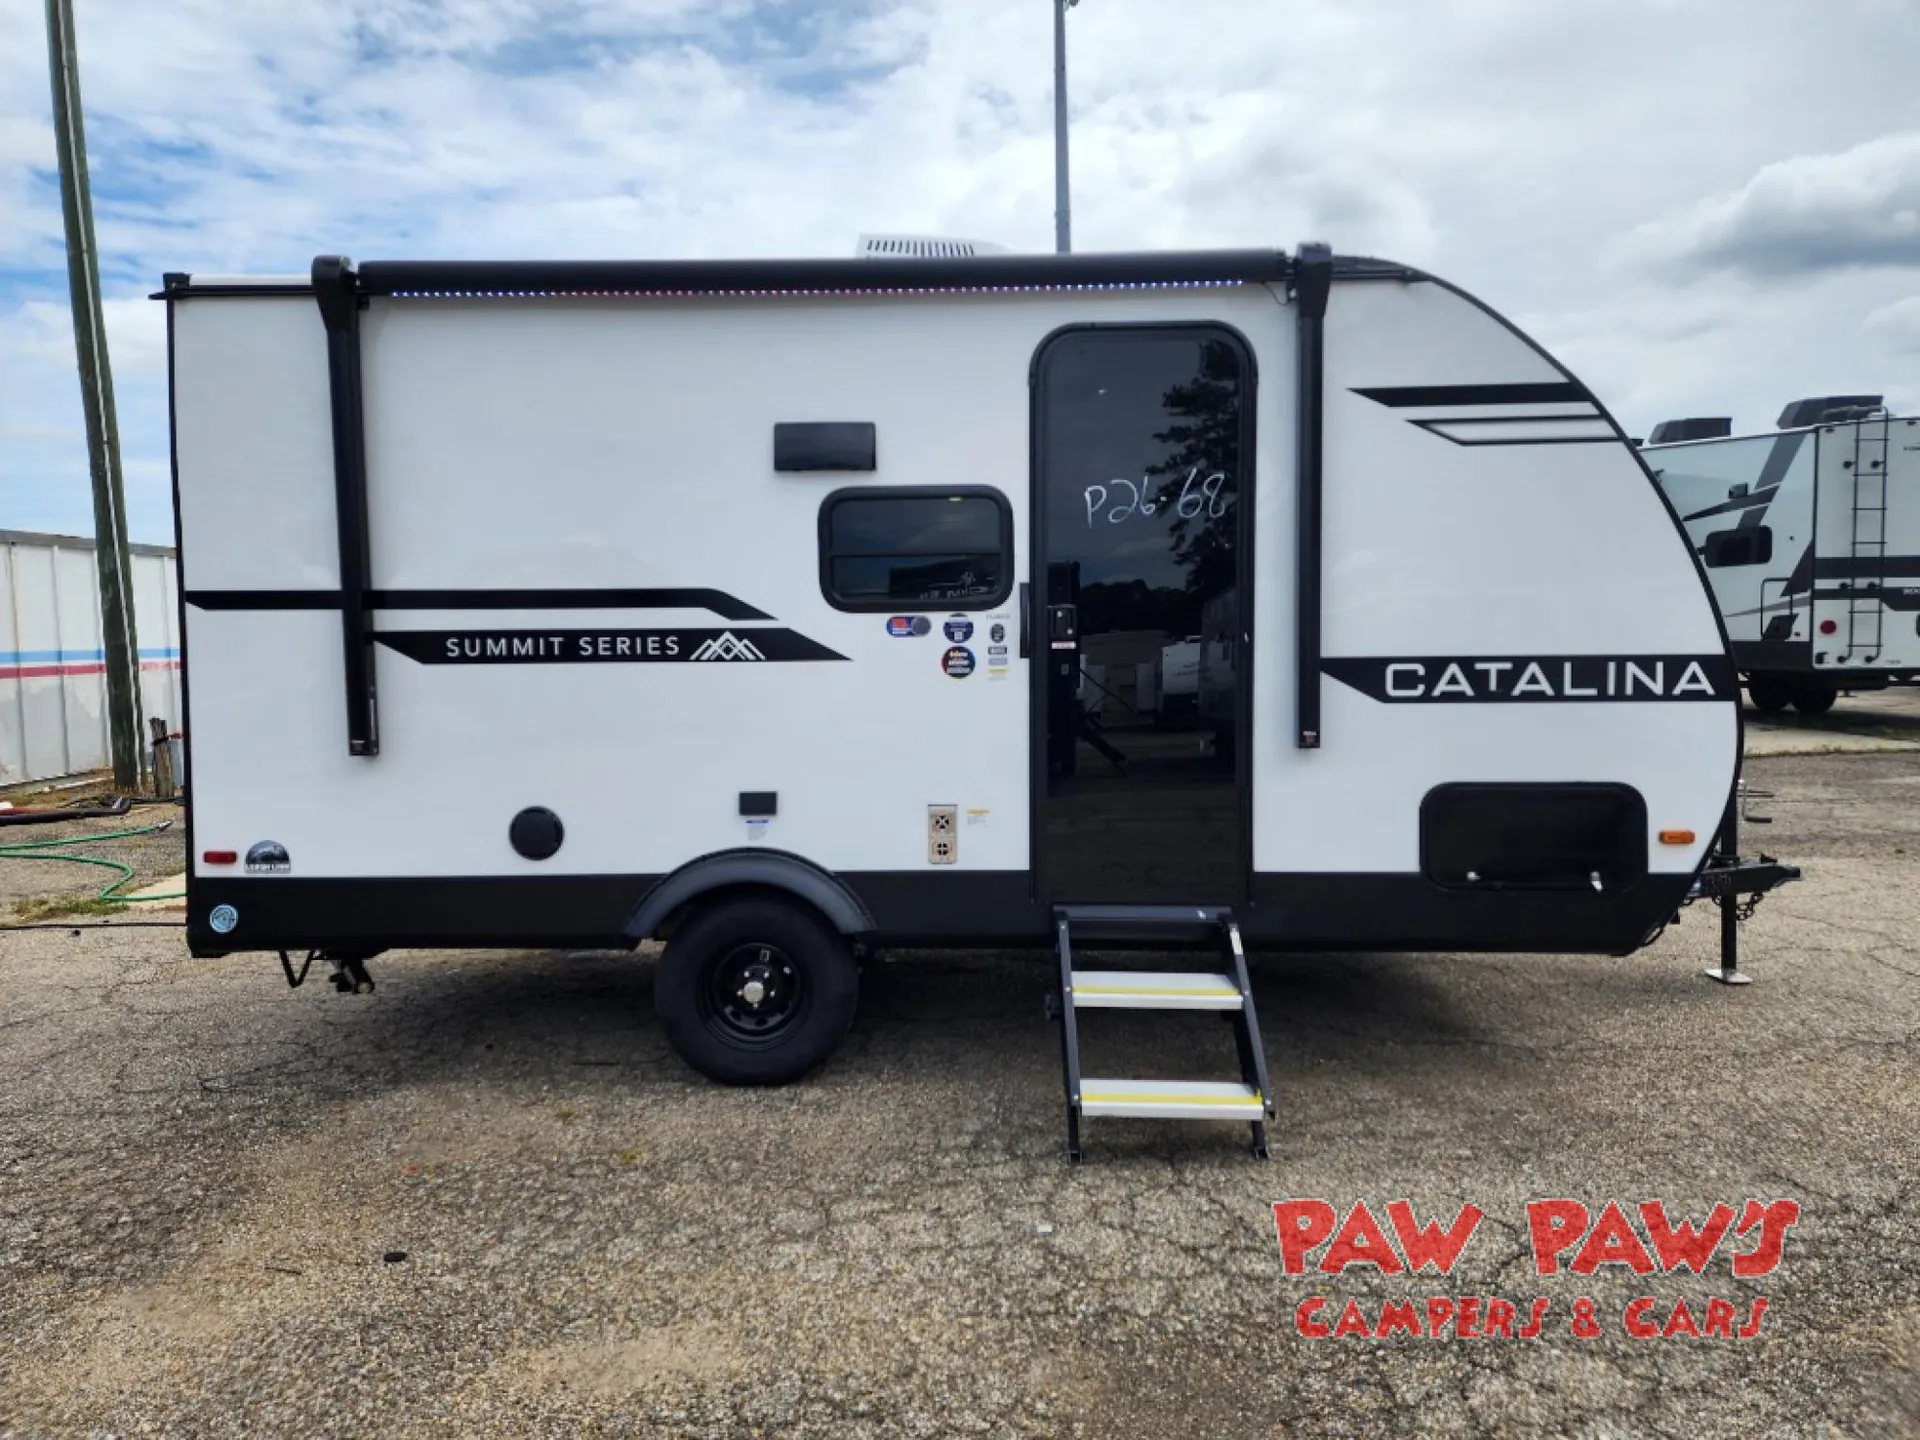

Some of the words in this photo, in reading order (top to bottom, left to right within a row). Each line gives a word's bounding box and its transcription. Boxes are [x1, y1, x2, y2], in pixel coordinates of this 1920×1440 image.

[445, 637, 565, 657] SUMMIT
[578, 636, 681, 656] SERIES
[1385, 661, 1717, 697] CATALINA
